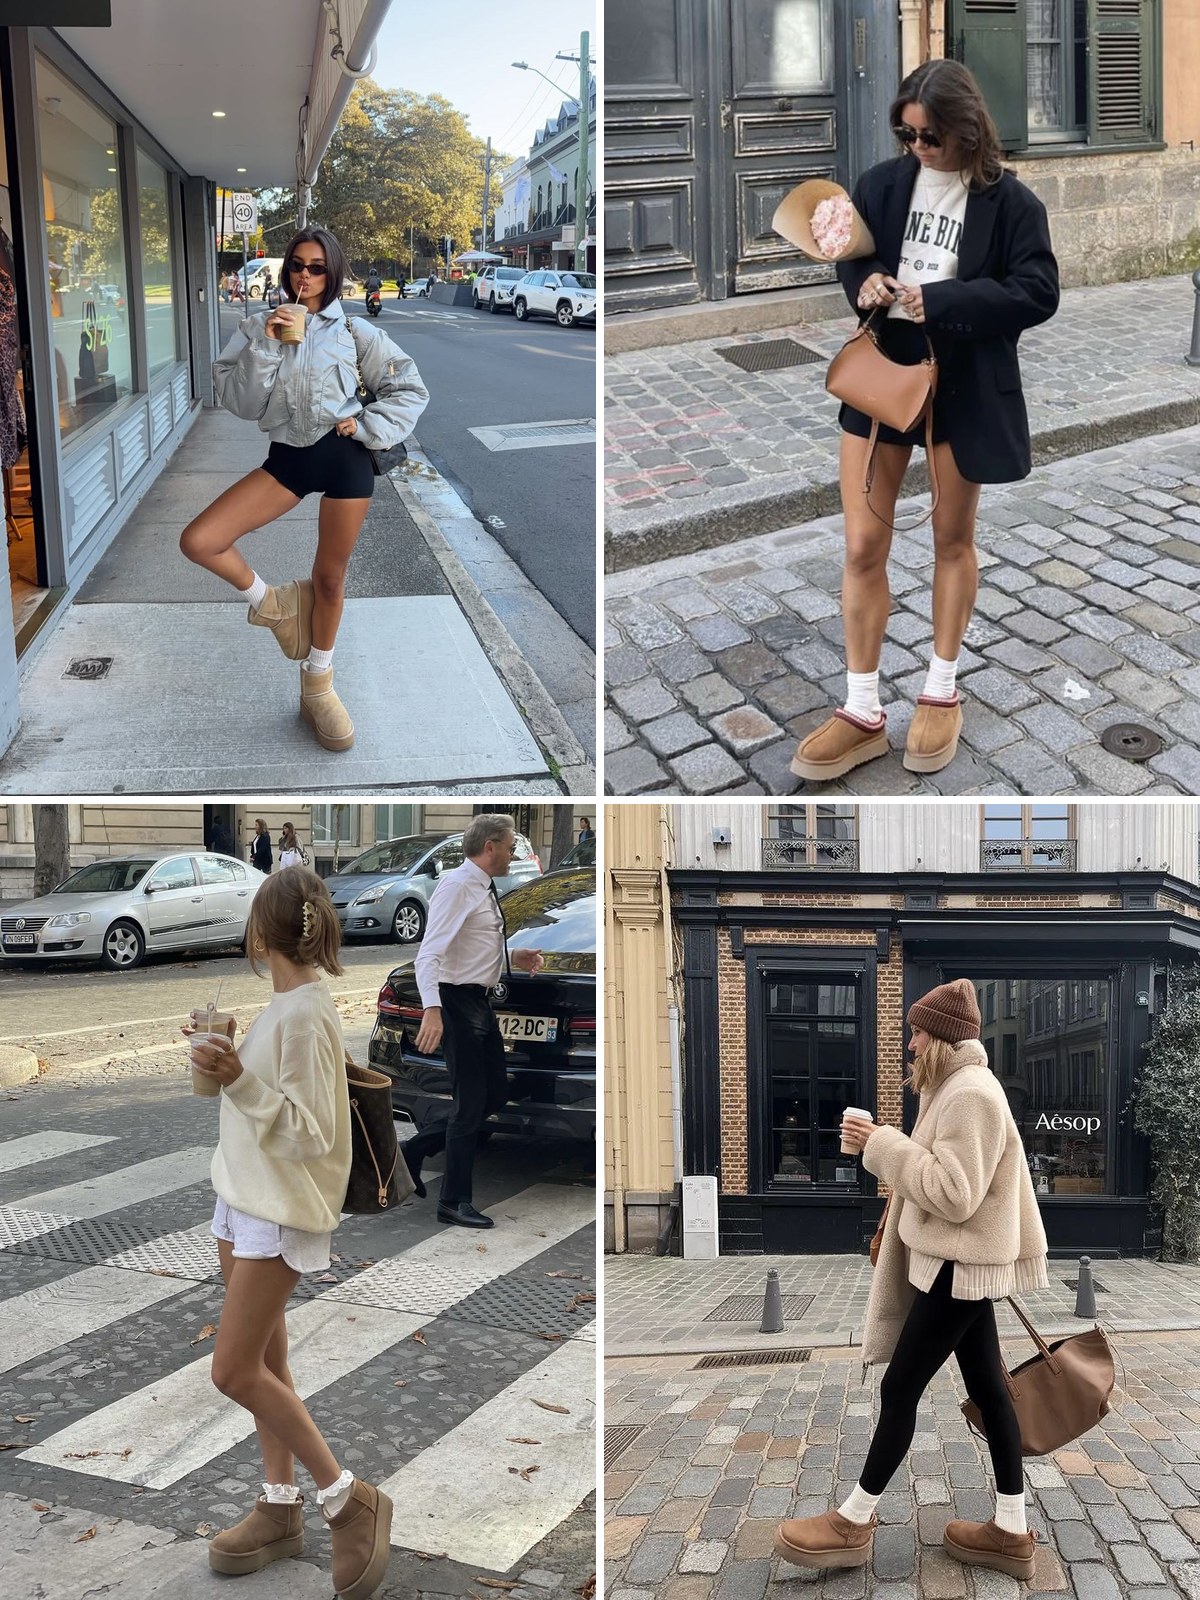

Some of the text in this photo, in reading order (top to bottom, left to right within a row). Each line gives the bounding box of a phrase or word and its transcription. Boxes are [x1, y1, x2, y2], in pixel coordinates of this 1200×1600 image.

[237, 207, 250, 218] 40
[498, 1017, 545, 1036] 12-DC
[547, 1030, 556, 1039] 93
[1035, 1113, 1101, 1135] Aêsop
